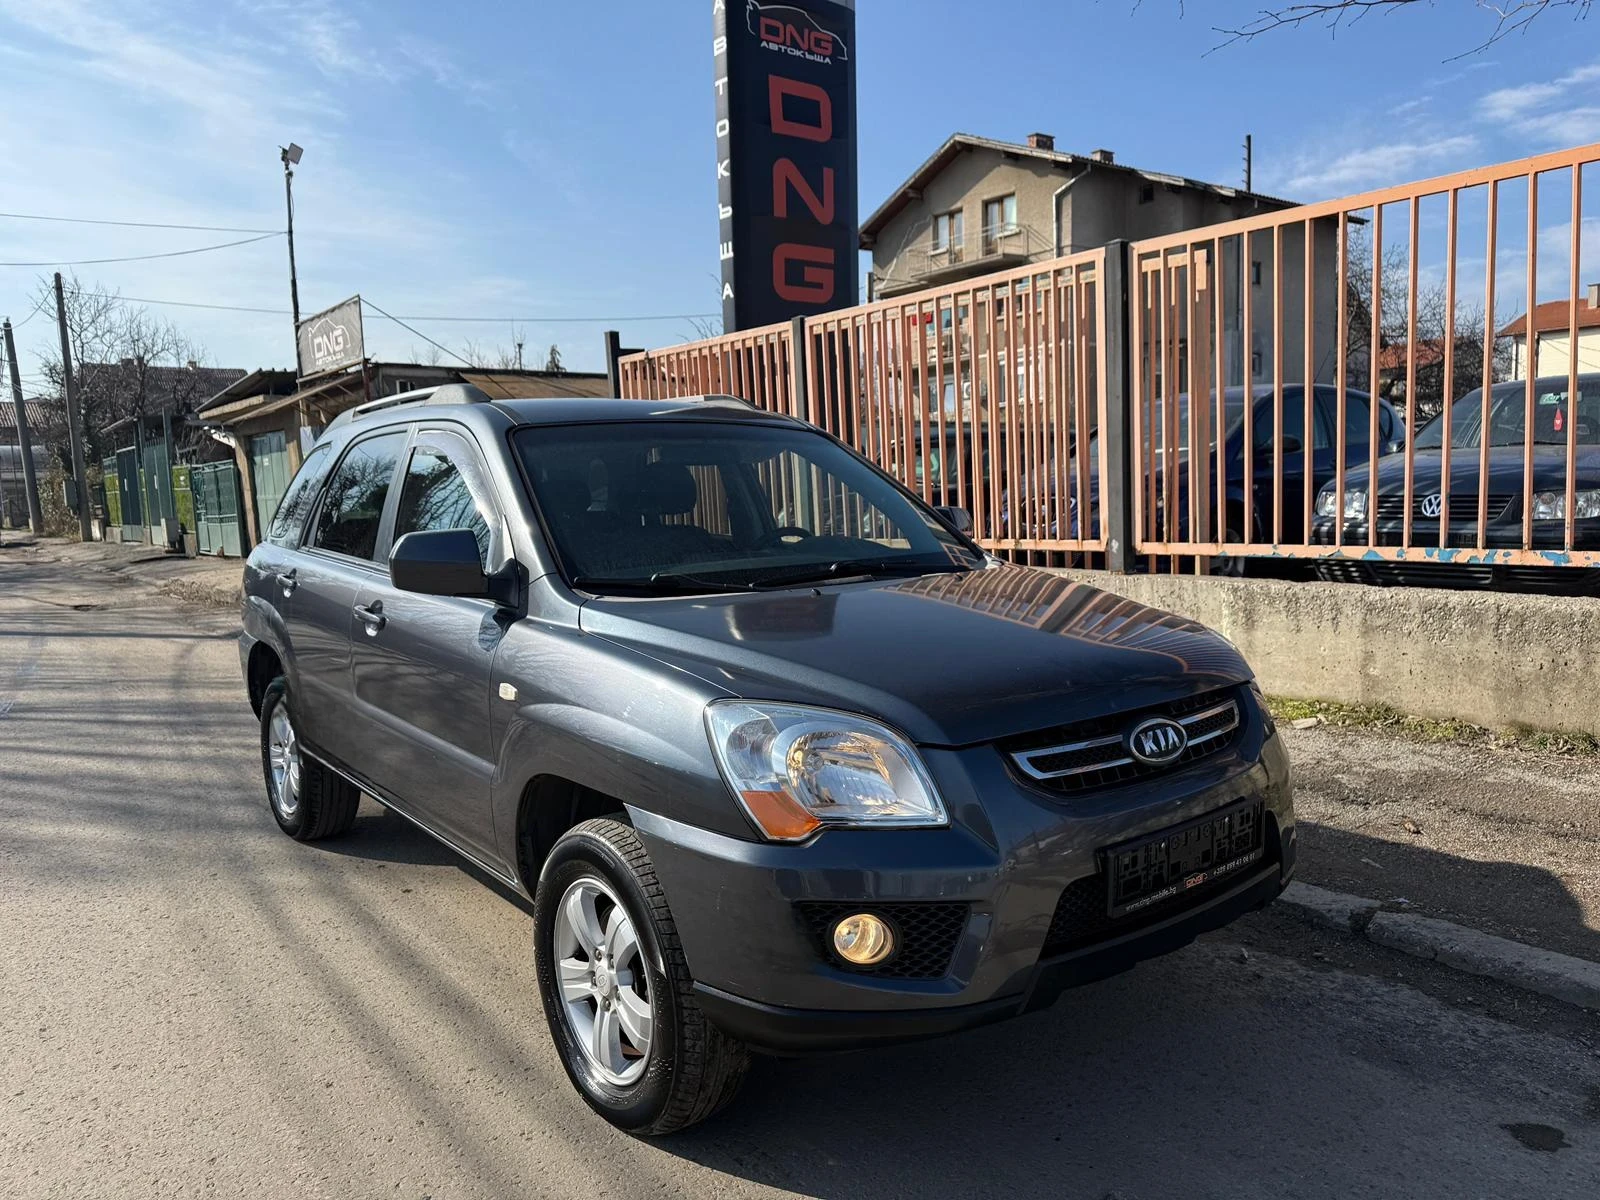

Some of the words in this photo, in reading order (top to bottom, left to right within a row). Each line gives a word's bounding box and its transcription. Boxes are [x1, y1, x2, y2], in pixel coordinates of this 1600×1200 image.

[760, 16, 832, 56] DNG
[760, 40, 832, 65] АВТОКЪША
[768, 74, 834, 304] DNG
[313, 329, 344, 359] DNG
[1139, 726, 1182, 756] KIA
